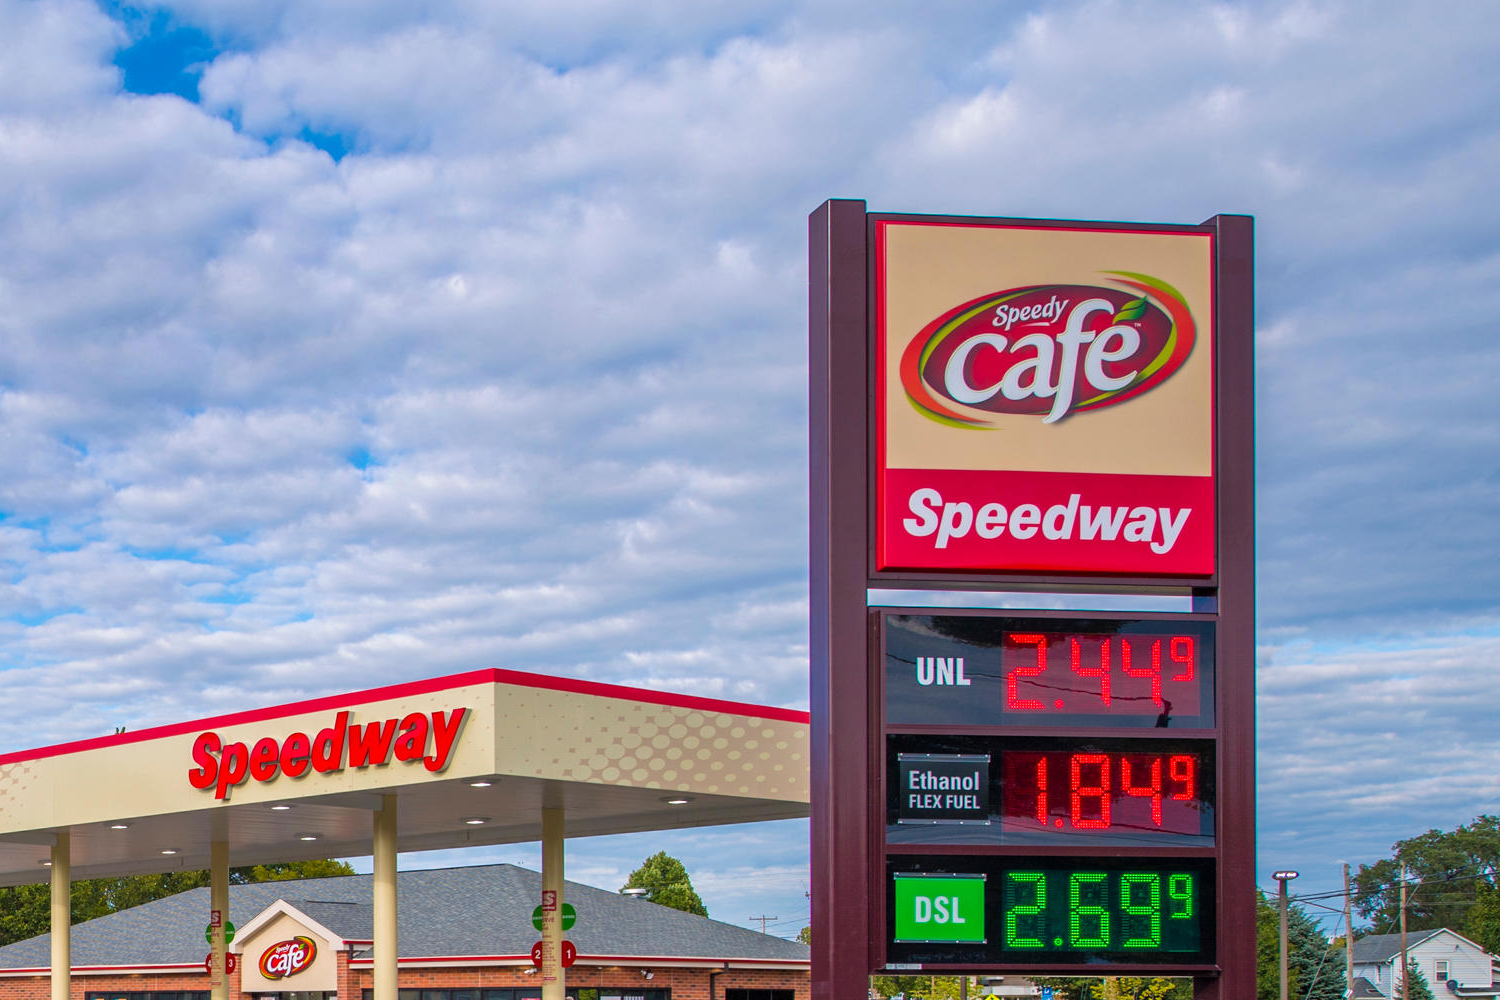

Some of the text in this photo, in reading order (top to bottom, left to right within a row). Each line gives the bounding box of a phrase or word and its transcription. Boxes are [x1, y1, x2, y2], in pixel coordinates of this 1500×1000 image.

[992, 296, 1069, 331] Speedy
[903, 488, 1191, 554] Speedway
[916, 657, 971, 686] UNL
[188, 707, 471, 800] Speedway
[909, 770, 980, 791] Ethanol
[909, 794, 980, 810] FLEX FUEL
[915, 895, 966, 924] DSL
[535, 949, 541, 960] 2
[565, 948, 571, 959] 1
